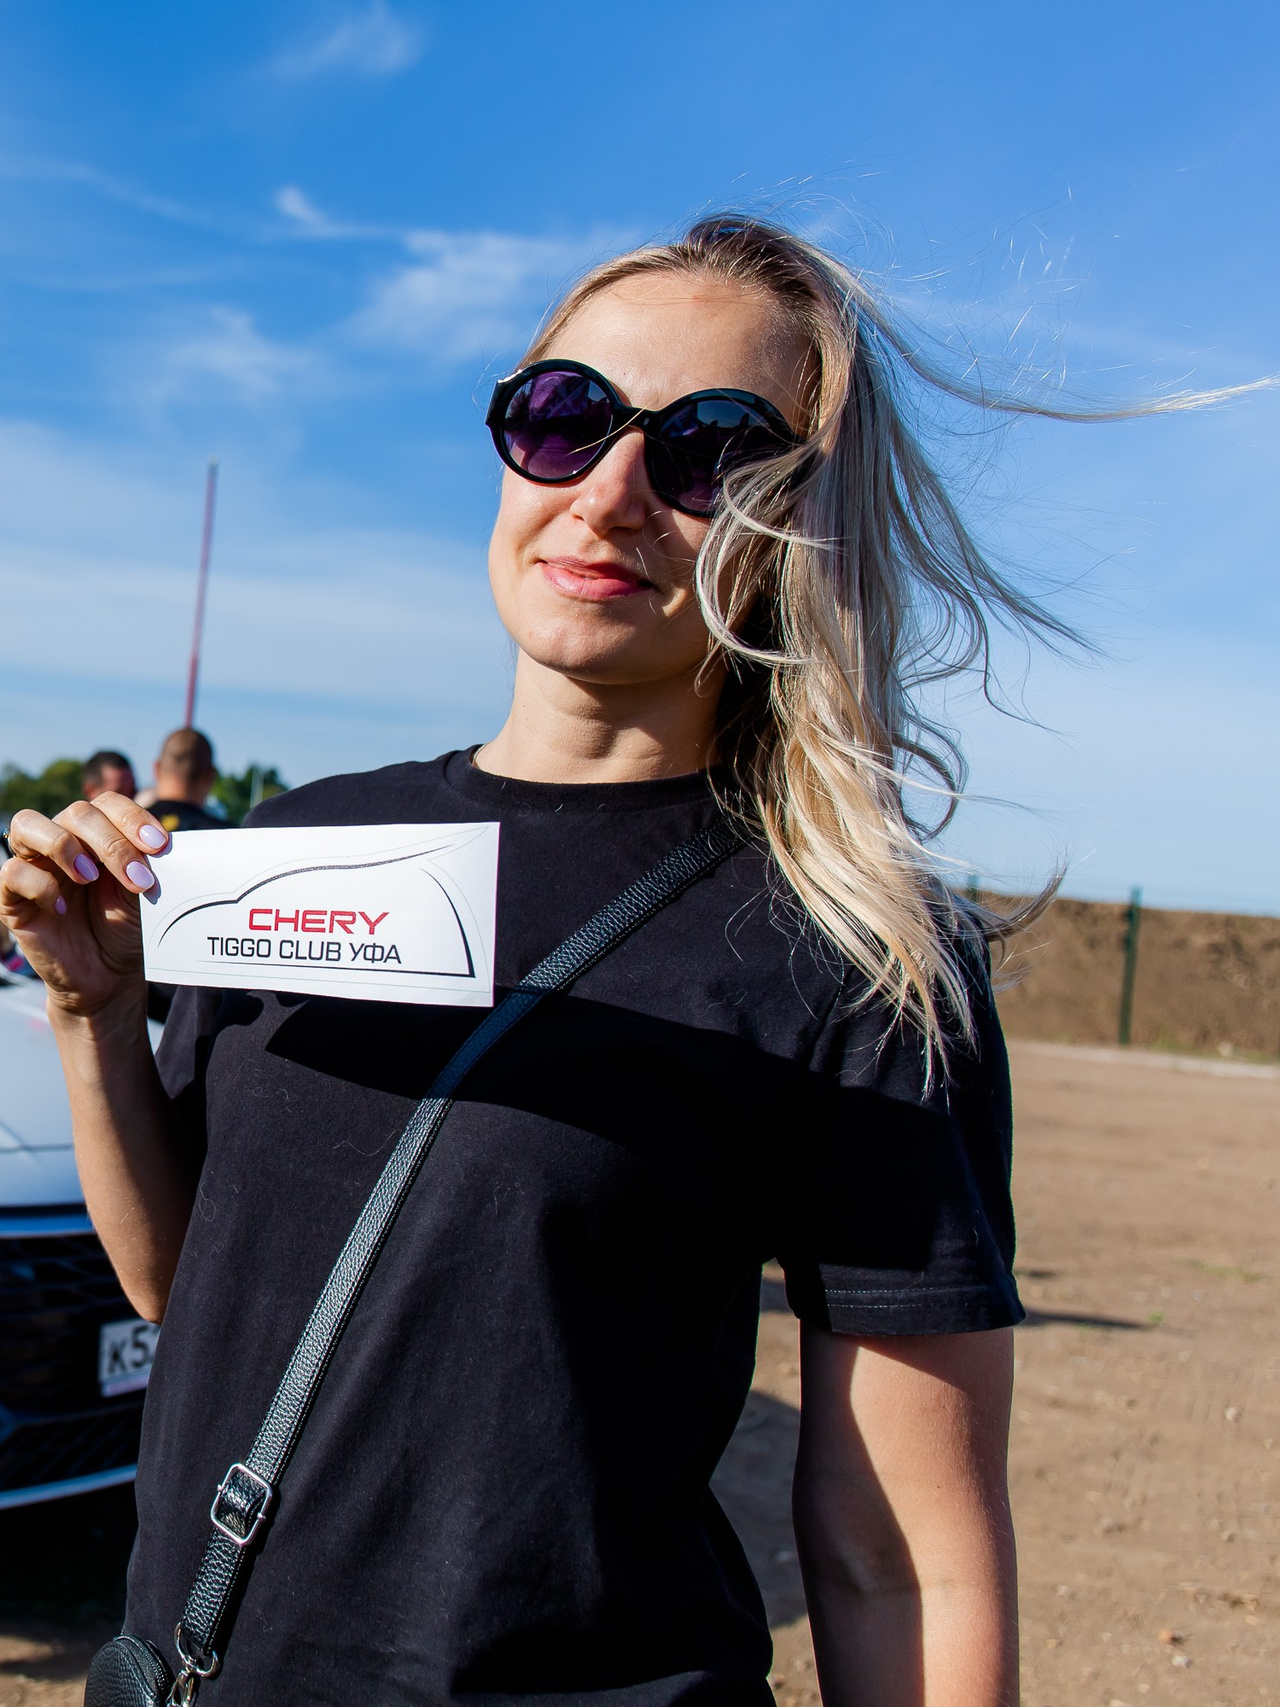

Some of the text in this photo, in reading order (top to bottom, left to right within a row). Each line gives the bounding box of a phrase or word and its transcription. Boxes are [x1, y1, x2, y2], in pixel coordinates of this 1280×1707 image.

[248, 908, 390, 935] CHERY
[207, 936, 402, 964] TIGGO CLUB УФА
[107, 1323, 161, 1374] К5
